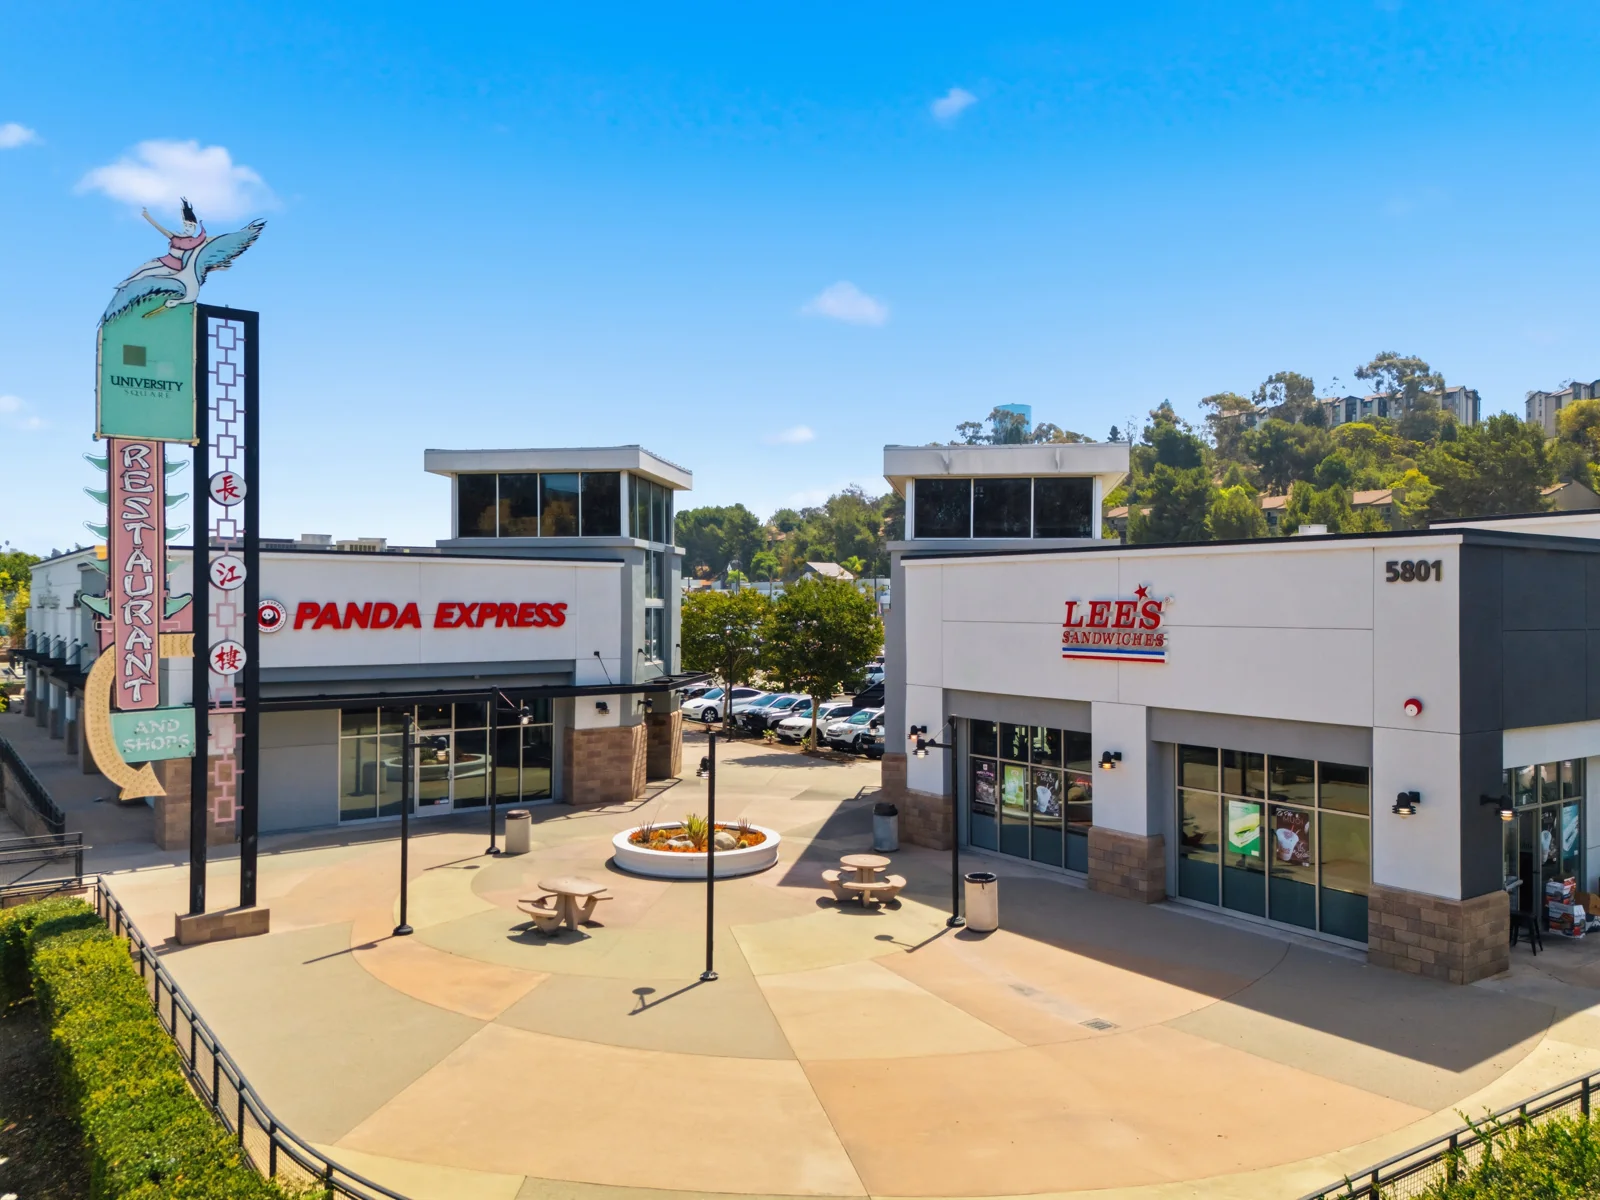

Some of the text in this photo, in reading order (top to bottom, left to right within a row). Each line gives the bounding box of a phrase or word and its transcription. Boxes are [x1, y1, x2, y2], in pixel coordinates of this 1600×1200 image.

[110, 375, 183, 391] UNIVERSITY
[123, 389, 170, 399] SQUARE
[120, 444, 155, 702] RESTAURANT
[1385, 560, 1442, 582] 5801
[293, 602, 422, 630] PANDA
[433, 602, 568, 628] EXPRESS
[1062, 630, 1164, 647] SANDWICHES
[135, 718, 180, 734] AND
[123, 734, 190, 753] SHOPS
